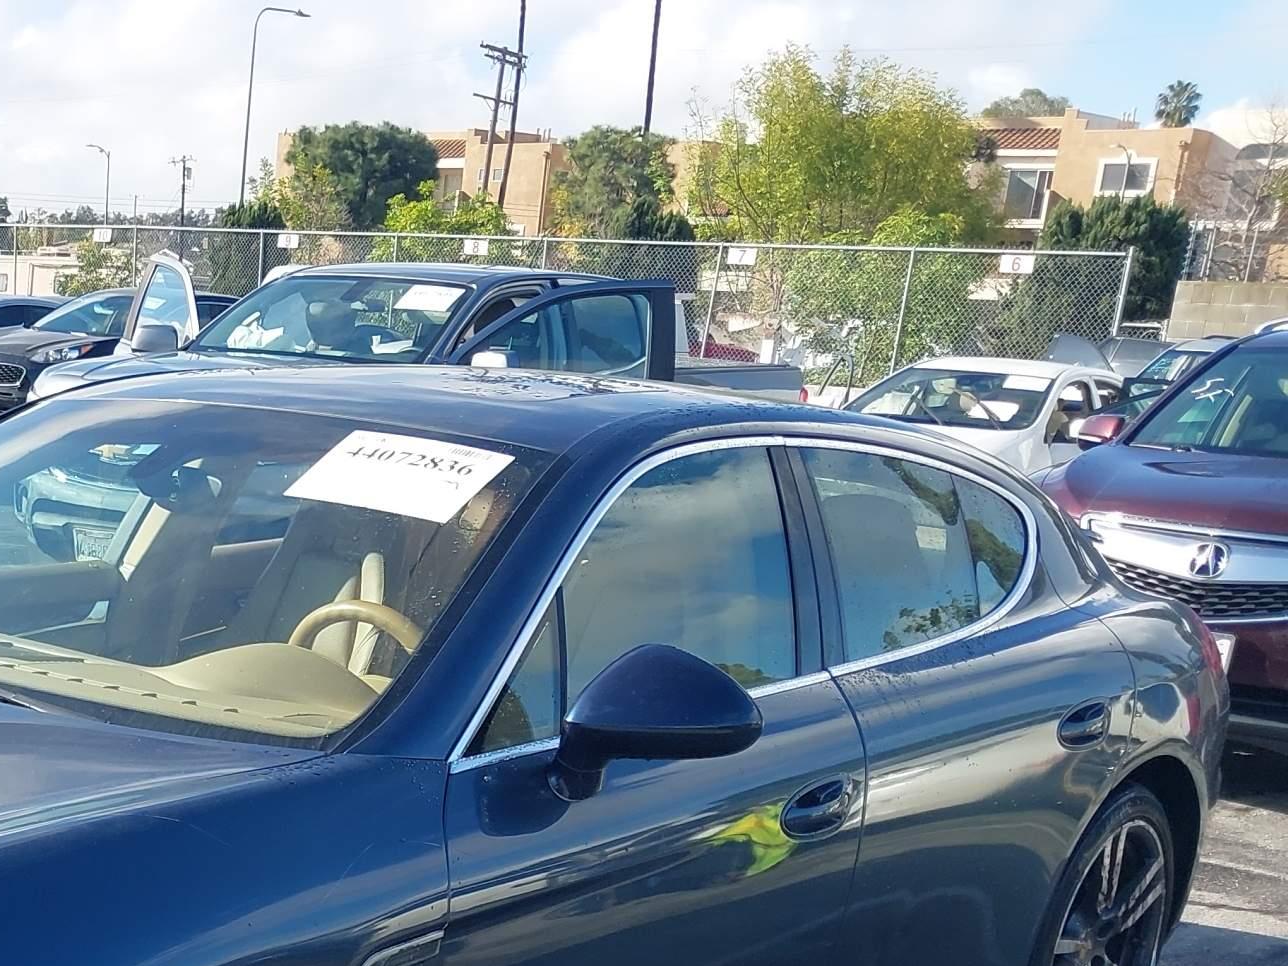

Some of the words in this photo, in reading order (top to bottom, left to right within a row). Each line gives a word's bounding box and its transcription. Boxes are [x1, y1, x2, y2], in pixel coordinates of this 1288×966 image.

[98, 230, 108, 241] 10
[472, 241, 480, 254] 8
[738, 249, 748, 263] 7
[1011, 256, 1022, 272] 6
[347, 446, 473, 477] 44072836
